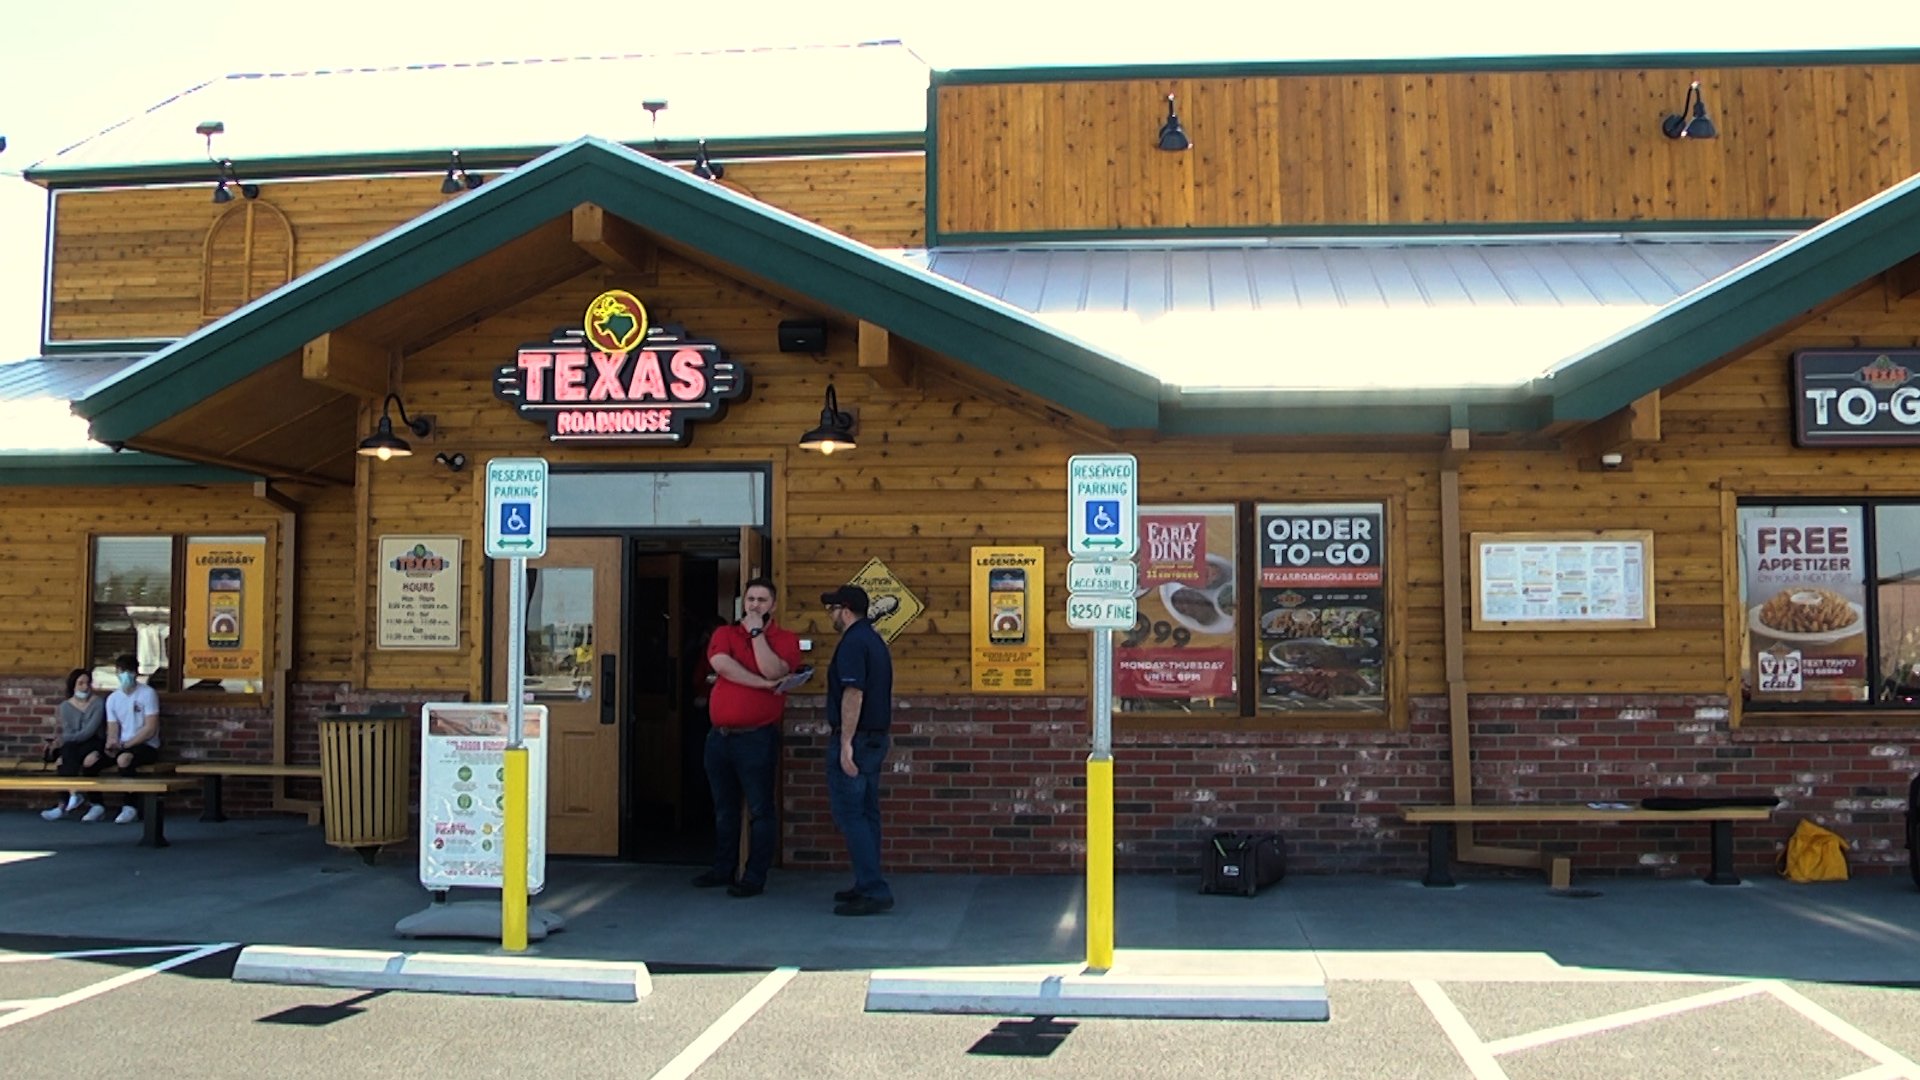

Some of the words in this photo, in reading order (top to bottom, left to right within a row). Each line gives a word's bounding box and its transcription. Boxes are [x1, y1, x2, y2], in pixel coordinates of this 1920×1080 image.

[517, 348, 707, 402] TEXAS
[557, 409, 672, 434] ROADHOUSE
[491, 470, 542, 482] RESERVED
[1074, 465, 1131, 479] RESERVED
[494, 486, 538, 499] PARKING
[1078, 482, 1127, 496] PARKING
[1146, 522, 1200, 543] EARLY
[1267, 518, 1372, 541] ORDER
[1757, 526, 1849, 555] FREE
[1150, 541, 1196, 561] DINE
[1269, 542, 1370, 566] TO-GO
[977, 558, 1037, 566] LEGENDARY
[1758, 558, 1851, 571] APPETIZER
[1094, 566, 1111, 576] VAN
[1263, 572, 1379, 581] TEXASROADHOUSE.COM
[402, 582, 435, 592] HOURS
[1073, 579, 1130, 590] ACCESSIBLE
[1071, 604, 1101, 619] $250
[1106, 604, 1133, 619] FINE
[1120, 661, 1225, 671] MONDAY-THURSDAY
[1761, 658, 1800, 676] VIP
[1144, 672, 1176, 682] UNTIL
[1762, 675, 1797, 689] club
